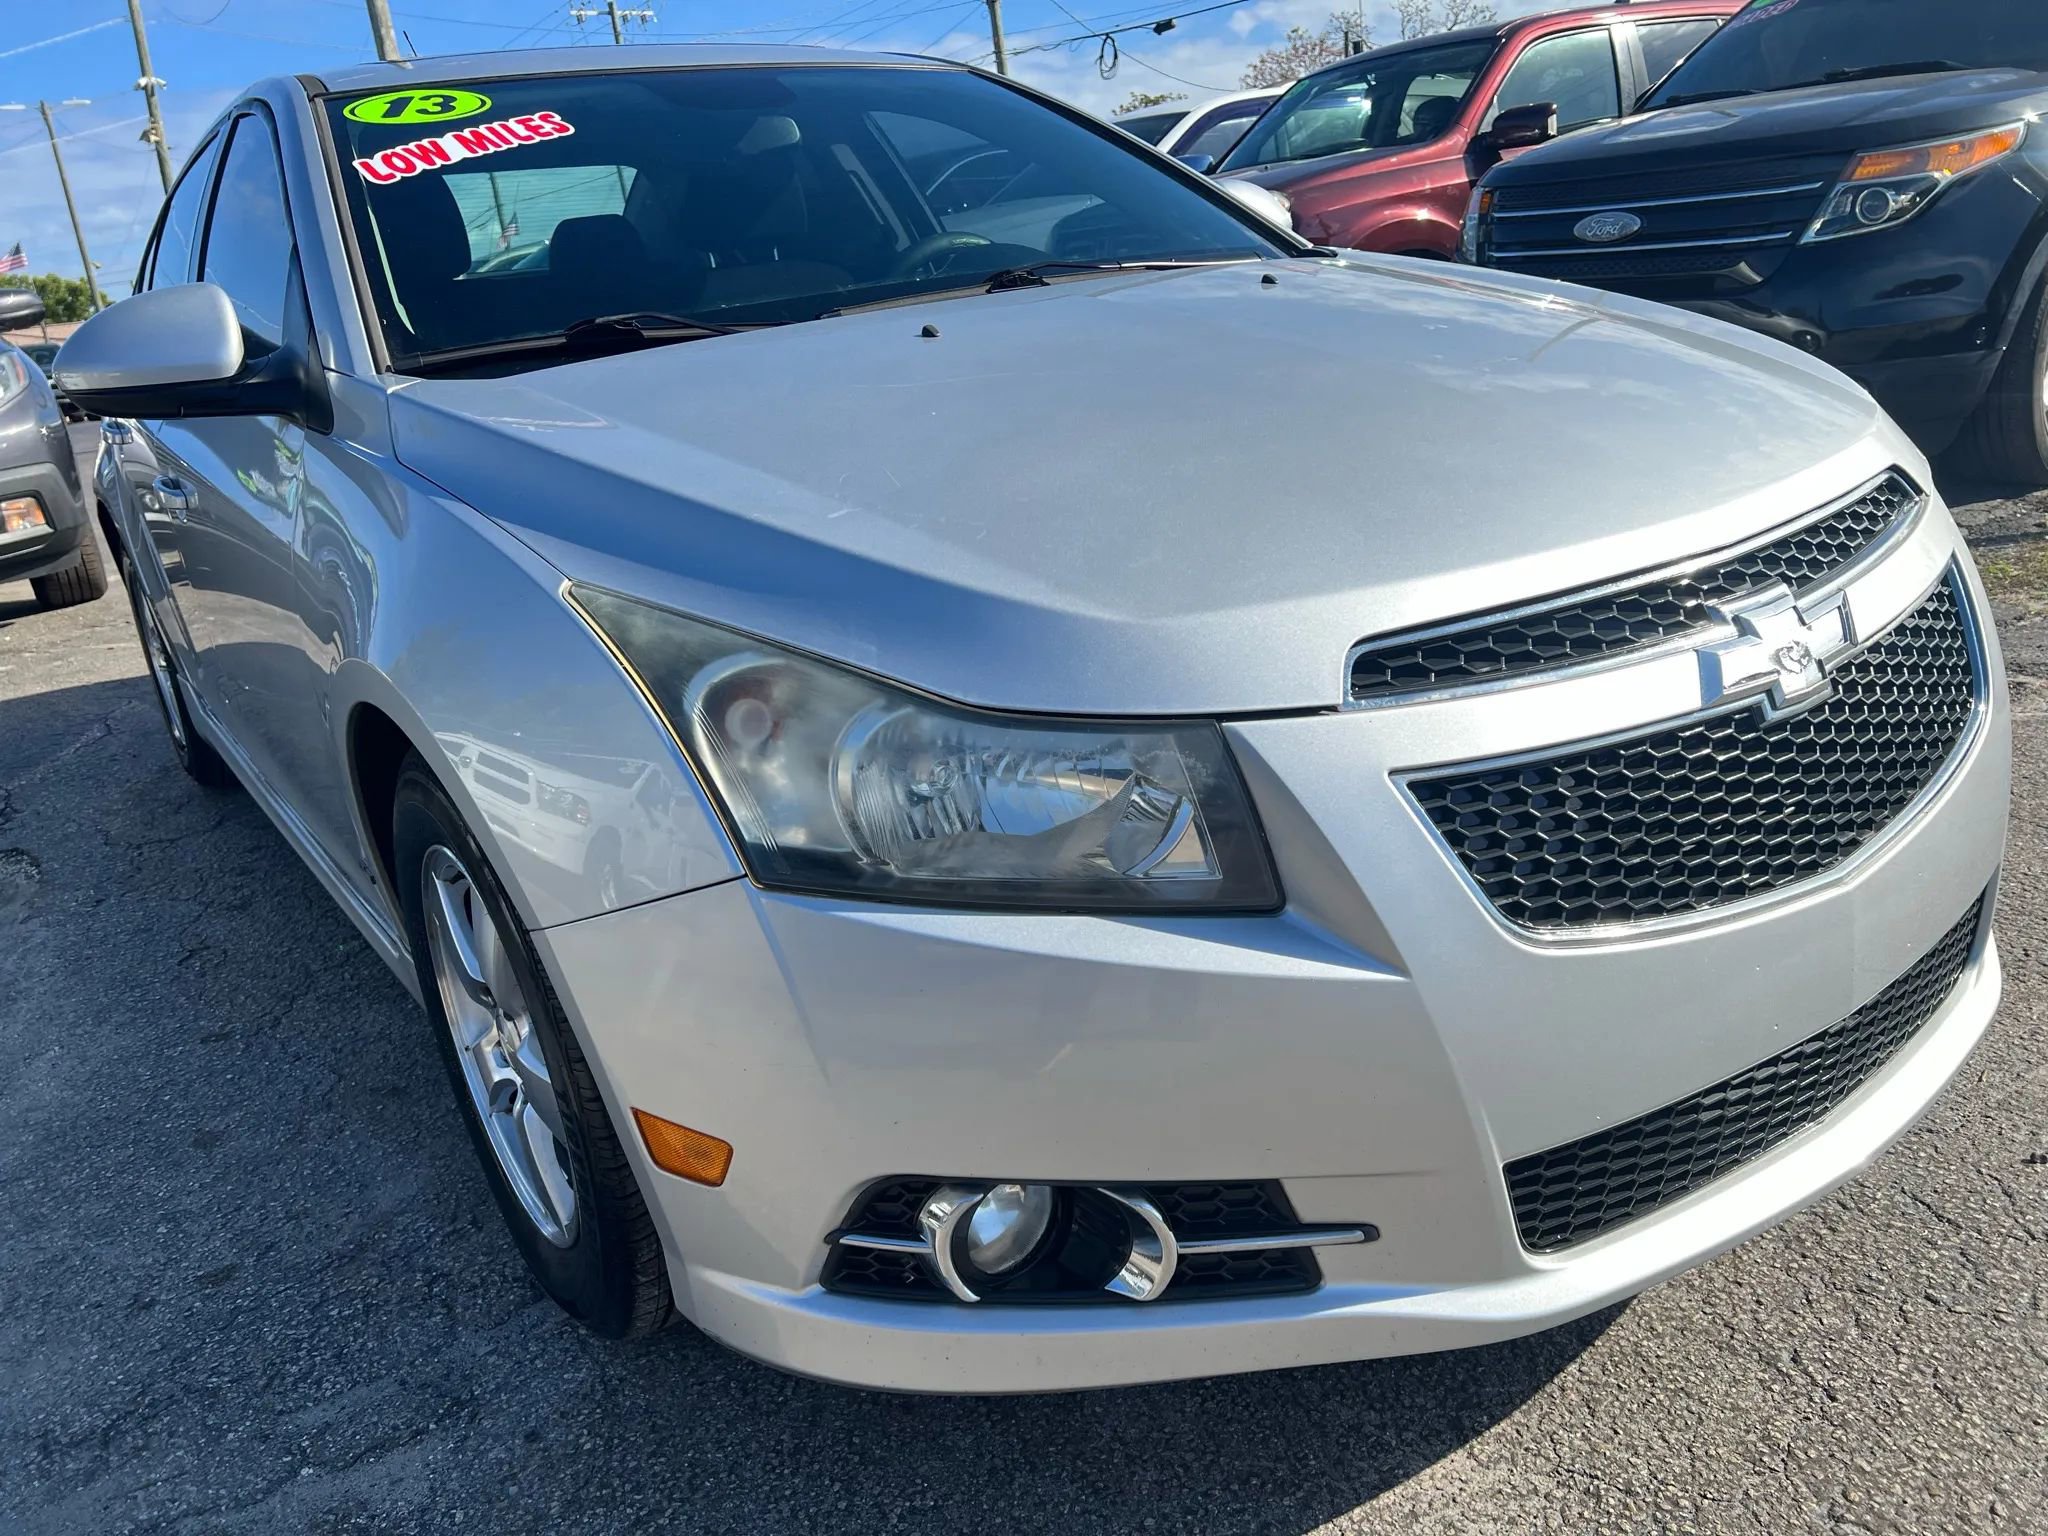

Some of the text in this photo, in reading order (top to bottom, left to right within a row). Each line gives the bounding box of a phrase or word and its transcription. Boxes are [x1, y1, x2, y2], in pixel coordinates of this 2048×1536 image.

[381, 94, 458, 119] 13
[357, 113, 571, 182] LOW MILES
[1586, 218, 1623, 236] Ford
